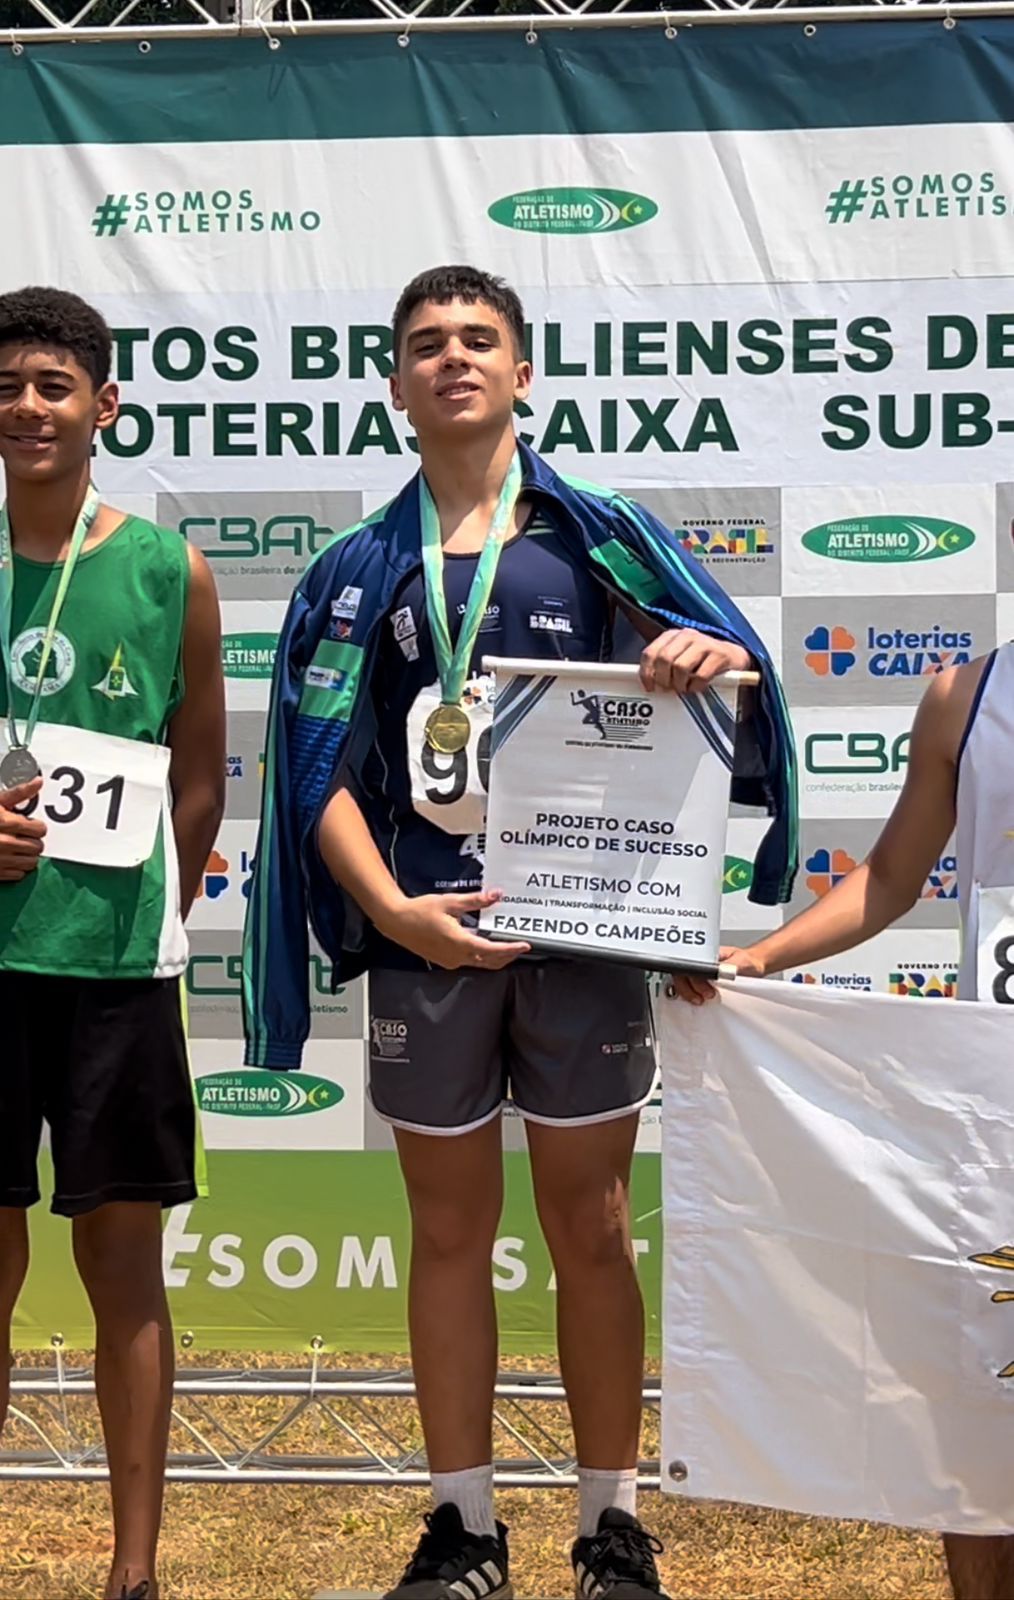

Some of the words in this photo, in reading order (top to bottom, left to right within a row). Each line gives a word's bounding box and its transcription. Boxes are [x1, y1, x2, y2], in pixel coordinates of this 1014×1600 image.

[514, 204, 594, 220] ATLETISMO
[870, 195, 1014, 219] ATLETIS
[134, 210, 321, 233] ATLETISMO
[291, 315, 894, 381] BRILIENSES
[927, 314, 1014, 371] DE
[90, 402, 420, 459] OTERIA
[727, 518, 766, 526] FEDERAL
[827, 533, 909, 549] ATLETISMO
[240, 566, 281, 575] brasileira
[868, 625, 972, 649] loterias
[222, 649, 277, 664] ETISM
[604, 700, 653, 718] CASO
[536, 813, 619, 831] PROJETO
[624, 819, 674, 836] CASO
[500, 829, 590, 849] OLÍMPICO
[595, 837, 620, 851] DE
[624, 839, 708, 858] SUCESSO
[526, 873, 632, 894] ATLETISMO
[637, 880, 681, 897] COM
[549, 899, 626, 912] TRANSFORMAÇÃO
[632, 906, 676, 916] INCLUSÃO
[677, 908, 708, 919] SOCIAL
[493, 915, 589, 936] FAZENDO
[594, 924, 707, 946] CAMPEÕES
[821, 973, 872, 986] loterias
[202, 1087, 280, 1102] ATLETISMO
